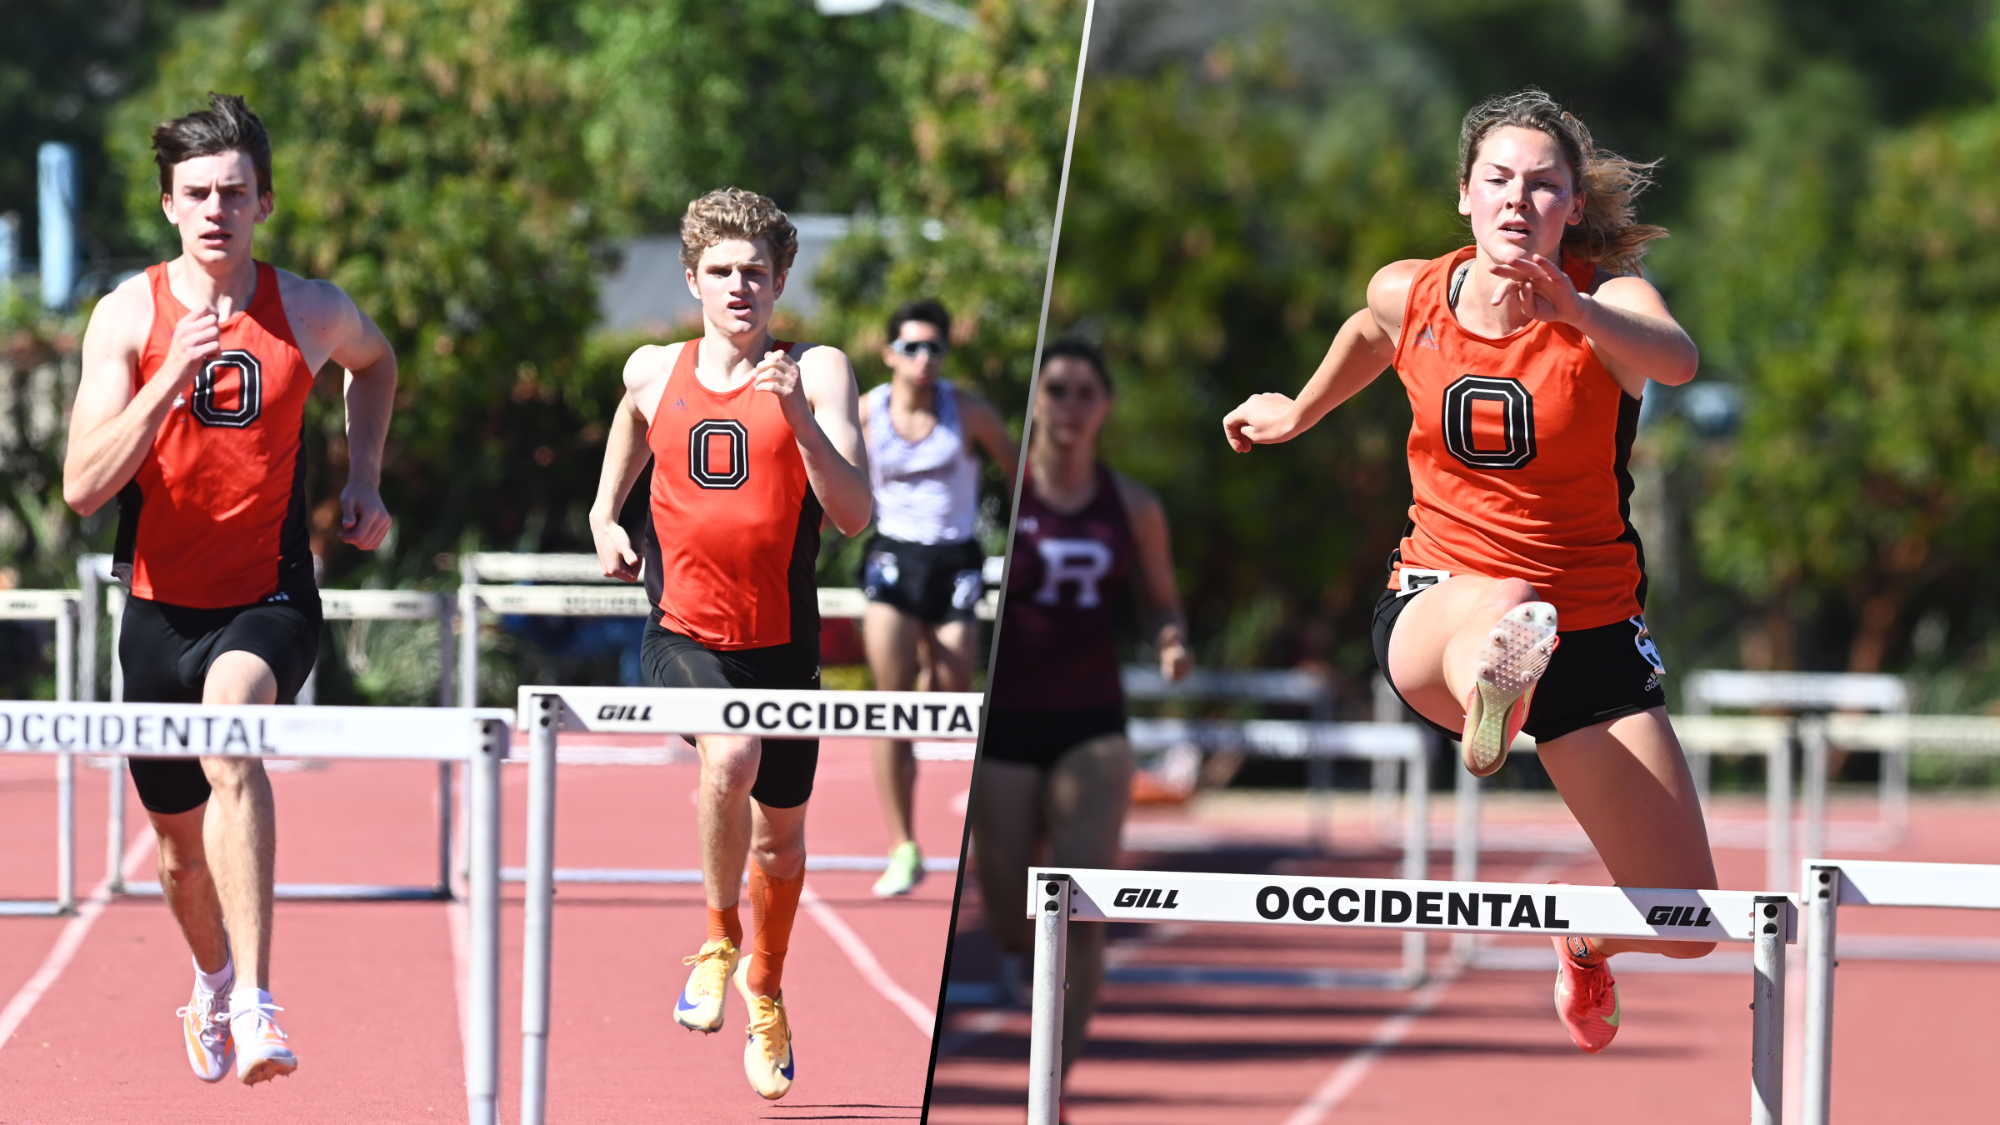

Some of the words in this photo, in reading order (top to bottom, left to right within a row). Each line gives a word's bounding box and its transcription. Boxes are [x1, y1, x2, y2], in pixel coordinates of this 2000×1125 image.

[1412, 338, 1440, 351] adidas
[191, 349, 261, 429] O
[1442, 374, 1537, 469] O
[688, 418, 749, 490] O
[1036, 538, 1114, 608] R
[597, 705, 652, 720] GILL
[723, 701, 983, 732] OCCIDENTA
[1113, 887, 1179, 909] GILL
[1256, 886, 1569, 929] OCCIDENTAL
[1646, 905, 1712, 927] GILL
